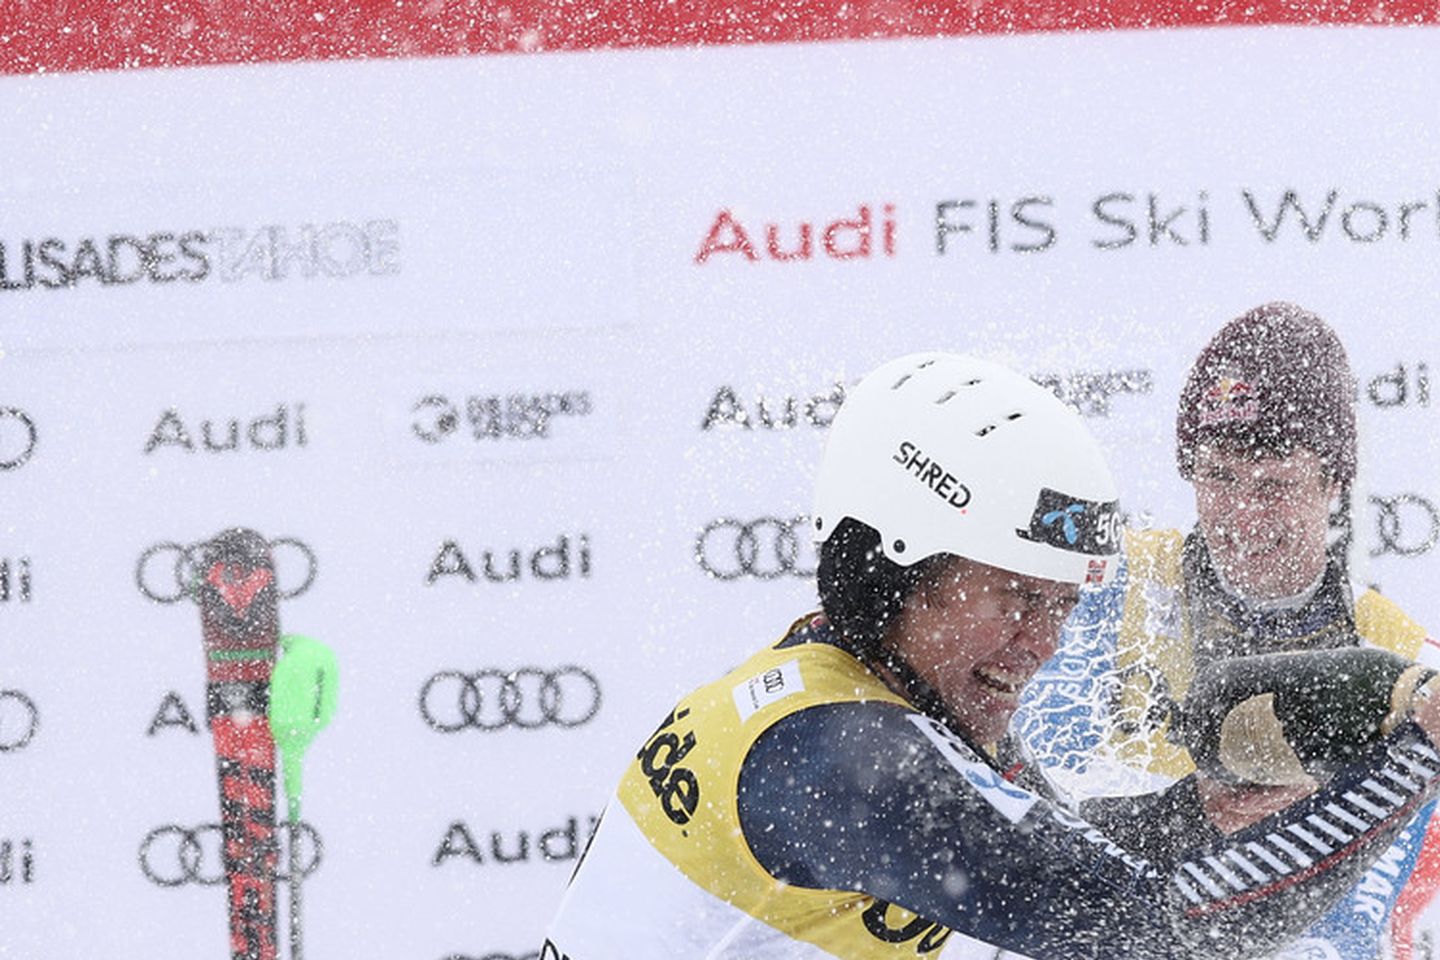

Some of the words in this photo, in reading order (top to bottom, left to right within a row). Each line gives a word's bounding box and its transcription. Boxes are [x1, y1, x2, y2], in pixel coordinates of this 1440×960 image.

[695, 203, 896, 264] Audi
[934, 196, 1056, 255] FIS
[1092, 190, 1212, 249] Ski
[701, 380, 849, 433] Aud
[1366, 361, 1431, 408] di
[144, 402, 308, 454] Audi
[427, 533, 592, 584] Audi
